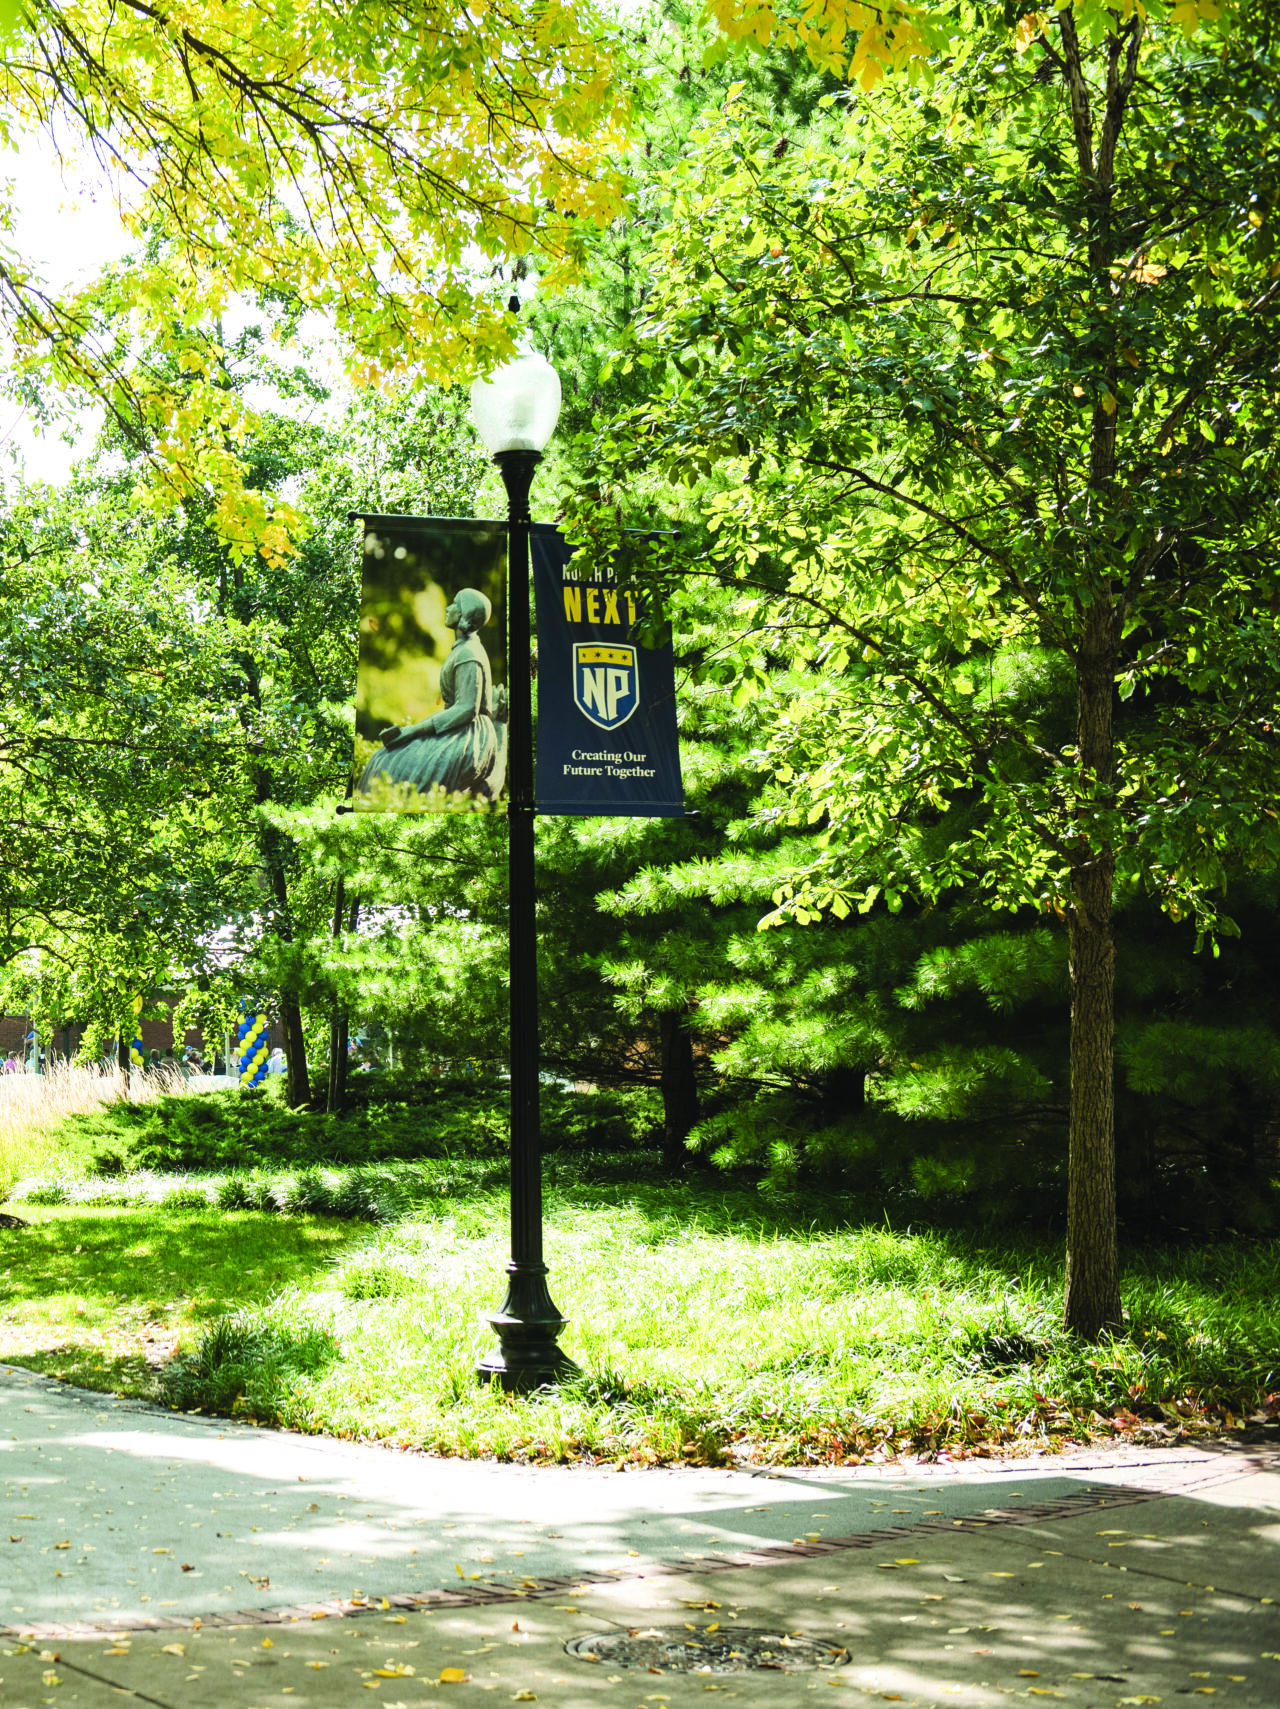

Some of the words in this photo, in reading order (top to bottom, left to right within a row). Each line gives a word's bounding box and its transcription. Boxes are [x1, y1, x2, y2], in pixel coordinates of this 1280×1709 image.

[562, 564, 602, 582] NOH
[563, 587, 639, 625] NEXT
[581, 667, 631, 721] NP
[571, 749, 622, 764] Creating
[623, 751, 646, 762] Our
[563, 764, 603, 776] Future
[605, 765, 656, 780] Together
